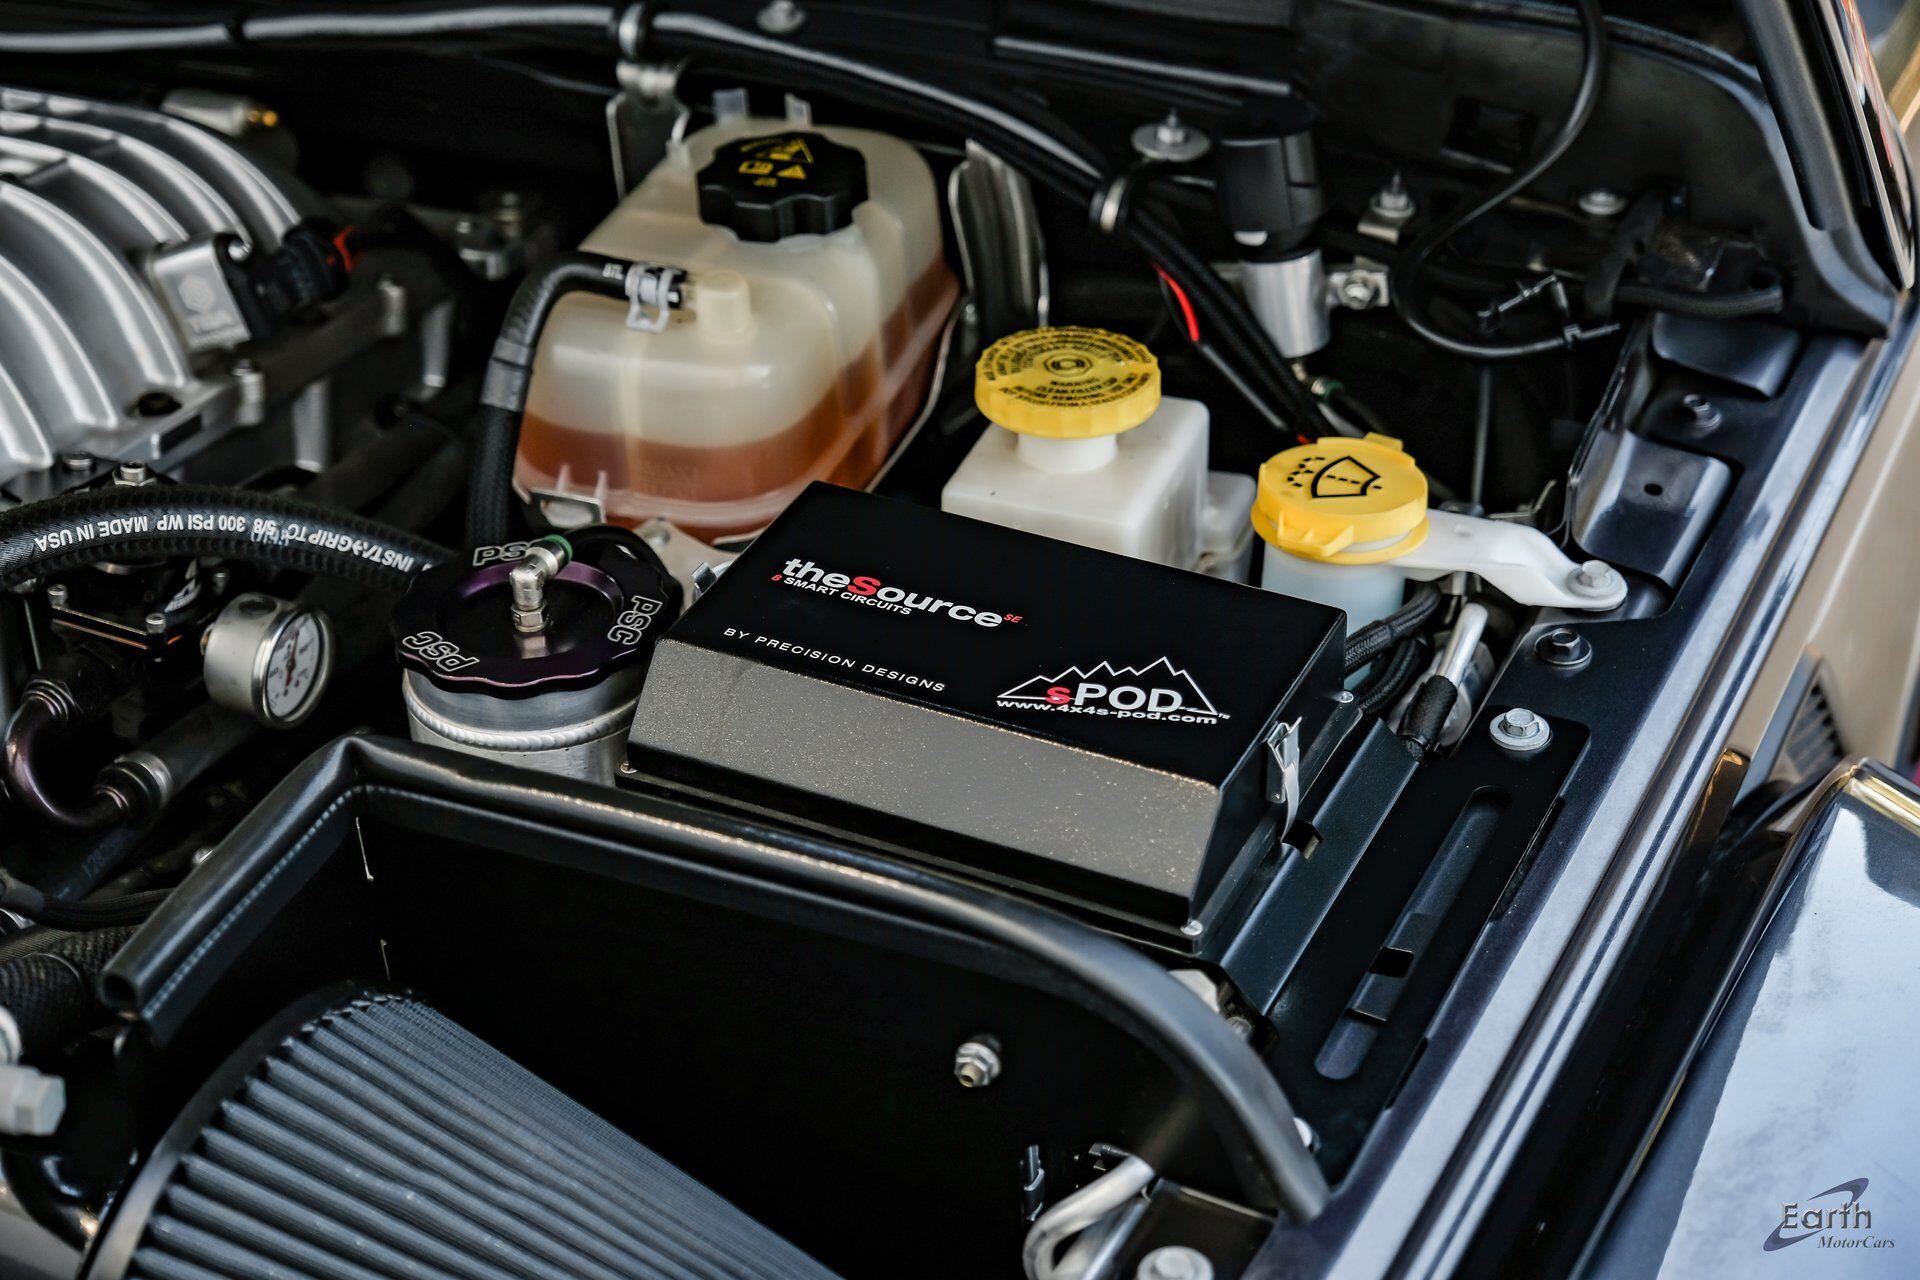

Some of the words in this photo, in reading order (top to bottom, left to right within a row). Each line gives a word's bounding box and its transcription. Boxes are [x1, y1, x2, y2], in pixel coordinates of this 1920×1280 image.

[76, 522, 95, 542] IN
[99, 515, 148, 538] MADE
[156, 514, 184, 531] WP
[188, 514, 215, 531] PSI
[217, 515, 246, 533] 300
[34, 528, 75, 553] USA
[472, 538, 539, 567] PS
[782, 558, 1003, 628] theSource
[1003, 613, 1023, 624] SE
[783, 577, 839, 597] SMART
[840, 592, 912, 616] CIRCUITS
[606, 595, 663, 645] PSC
[402, 631, 480, 672] PSC
[723, 627, 750, 640] BY
[754, 635, 857, 668] PRECISION
[861, 663, 946, 693] DESIGNS
[1045, 682, 1184, 714] sPOD
[996, 700, 1218, 726] www.4x4s-pod.com
